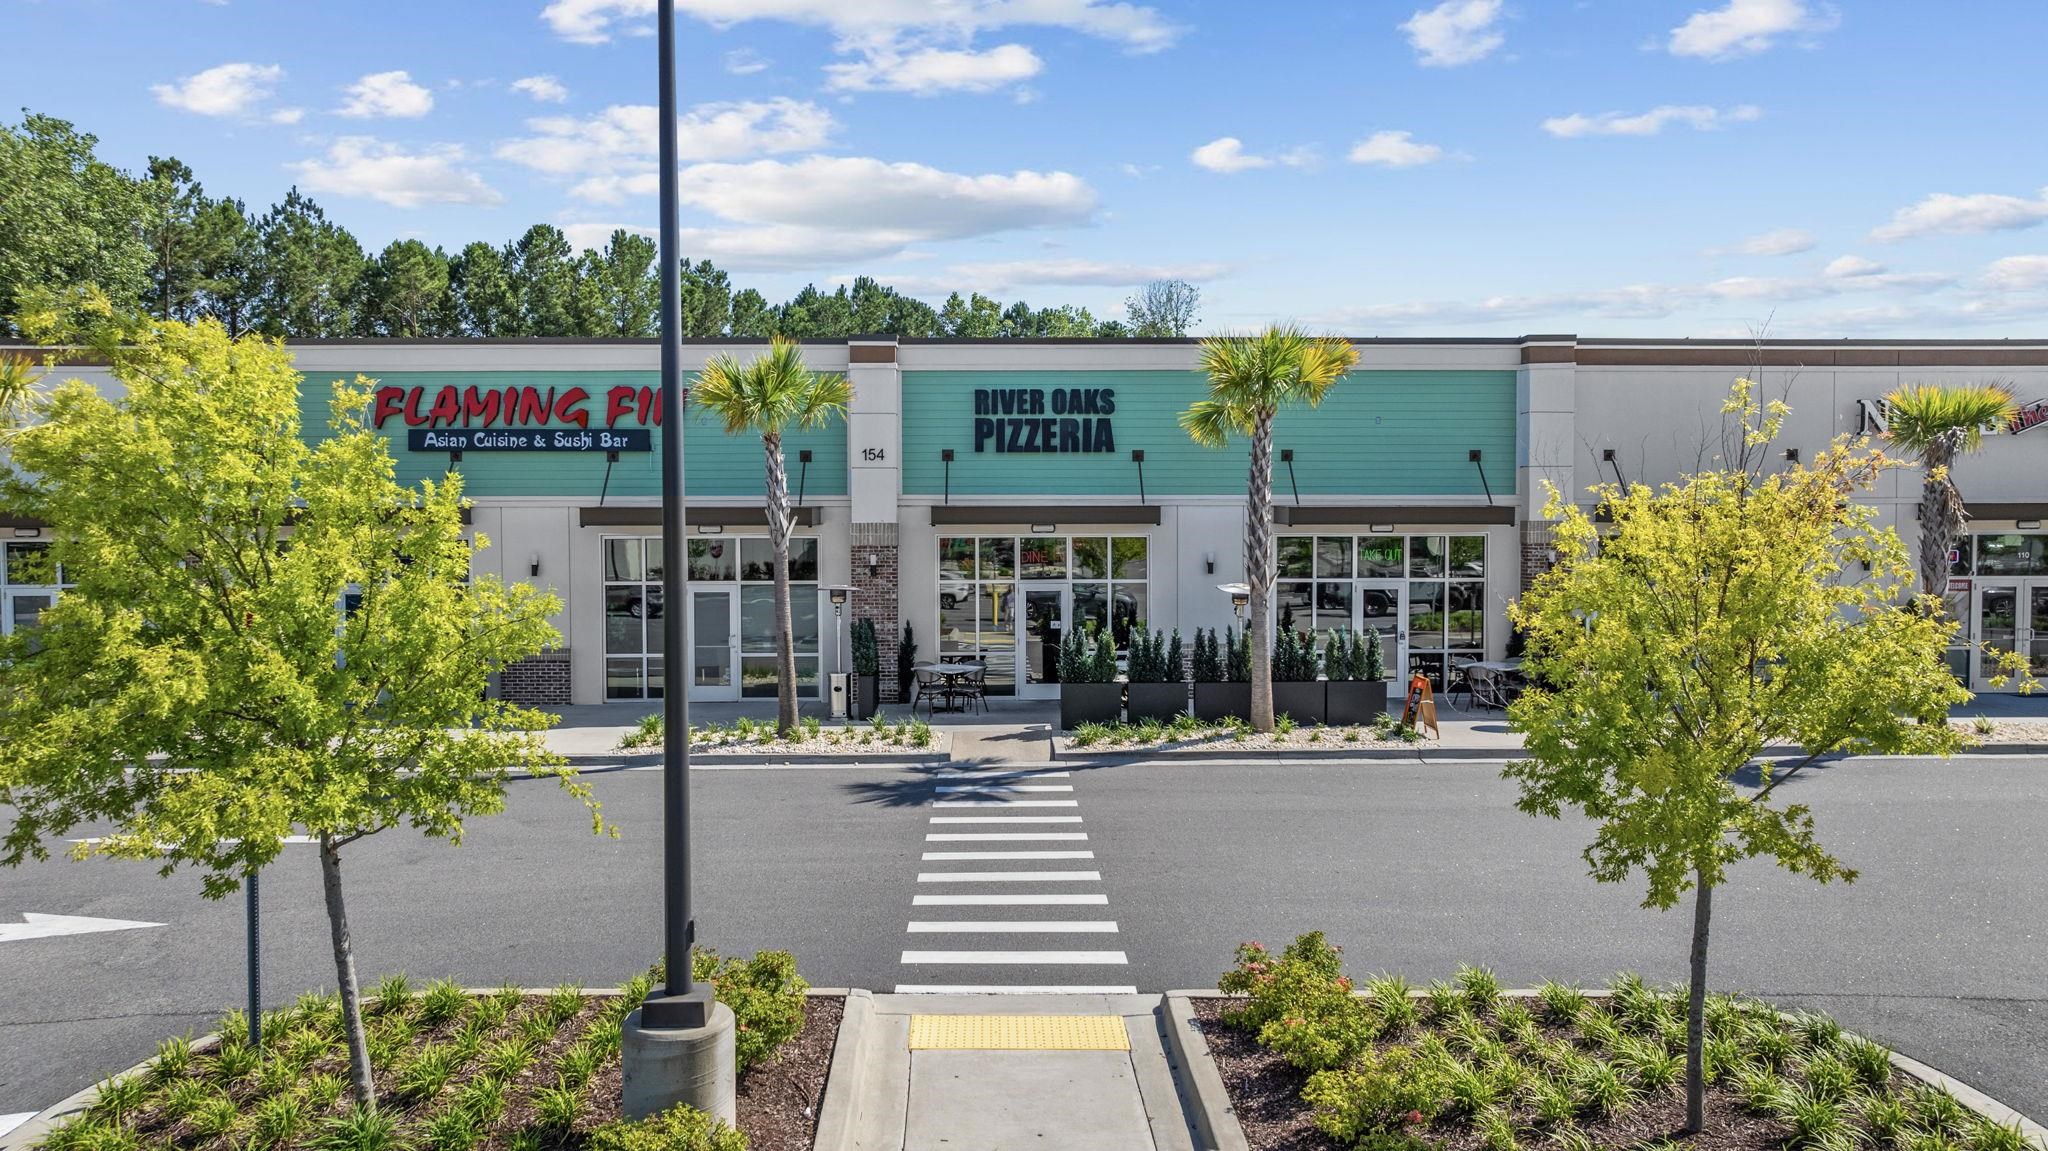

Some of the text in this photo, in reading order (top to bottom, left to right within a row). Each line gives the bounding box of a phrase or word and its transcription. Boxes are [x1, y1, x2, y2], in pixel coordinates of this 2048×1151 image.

[374, 385, 688, 429] FLAMING FI
[974, 388, 1116, 415] RIVER OAKS
[424, 432, 628, 451] Asian Cuisine & Sushi Bar
[974, 418, 1116, 453] PIZZERIA
[861, 448, 885, 462] 154
[1021, 551, 1048, 563] DINE
[1360, 549, 1402, 561] TAKE OUT
